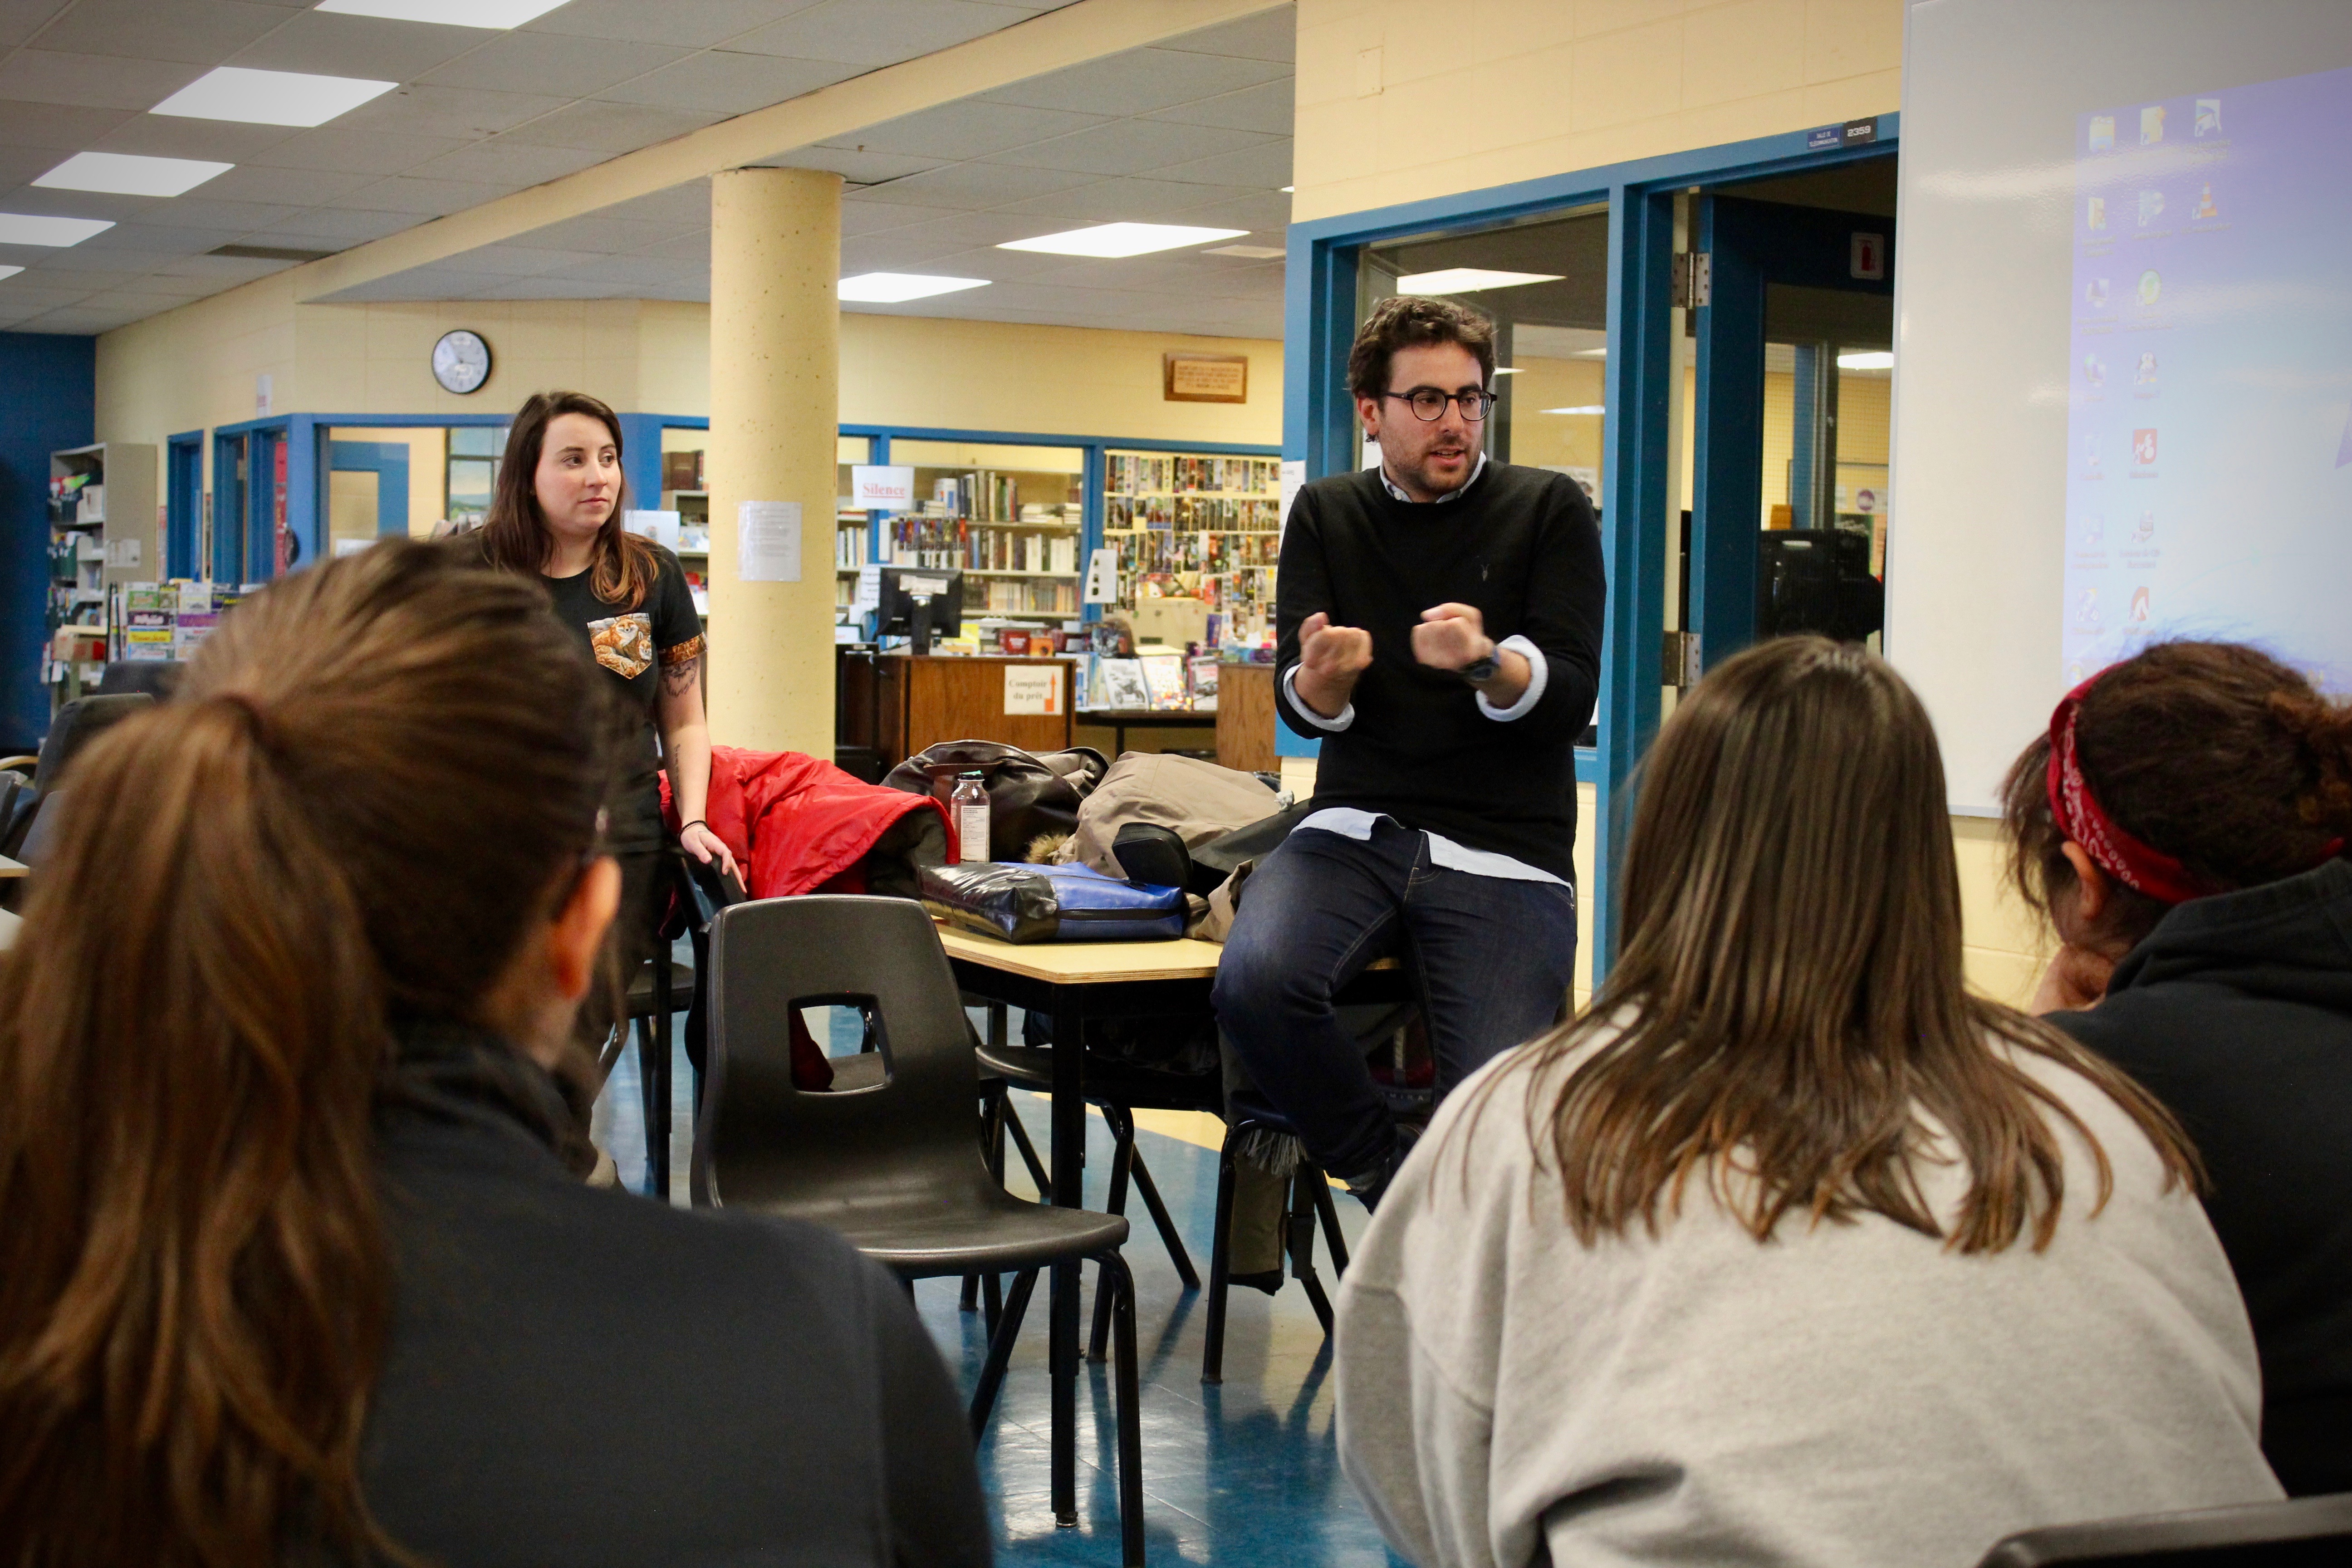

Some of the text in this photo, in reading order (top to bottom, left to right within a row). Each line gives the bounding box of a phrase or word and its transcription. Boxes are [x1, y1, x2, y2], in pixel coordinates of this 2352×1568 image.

[1847, 125, 1871, 137] 2359
[863, 483, 905, 495] Silence
[1009, 679, 1047, 689] Comptoir
